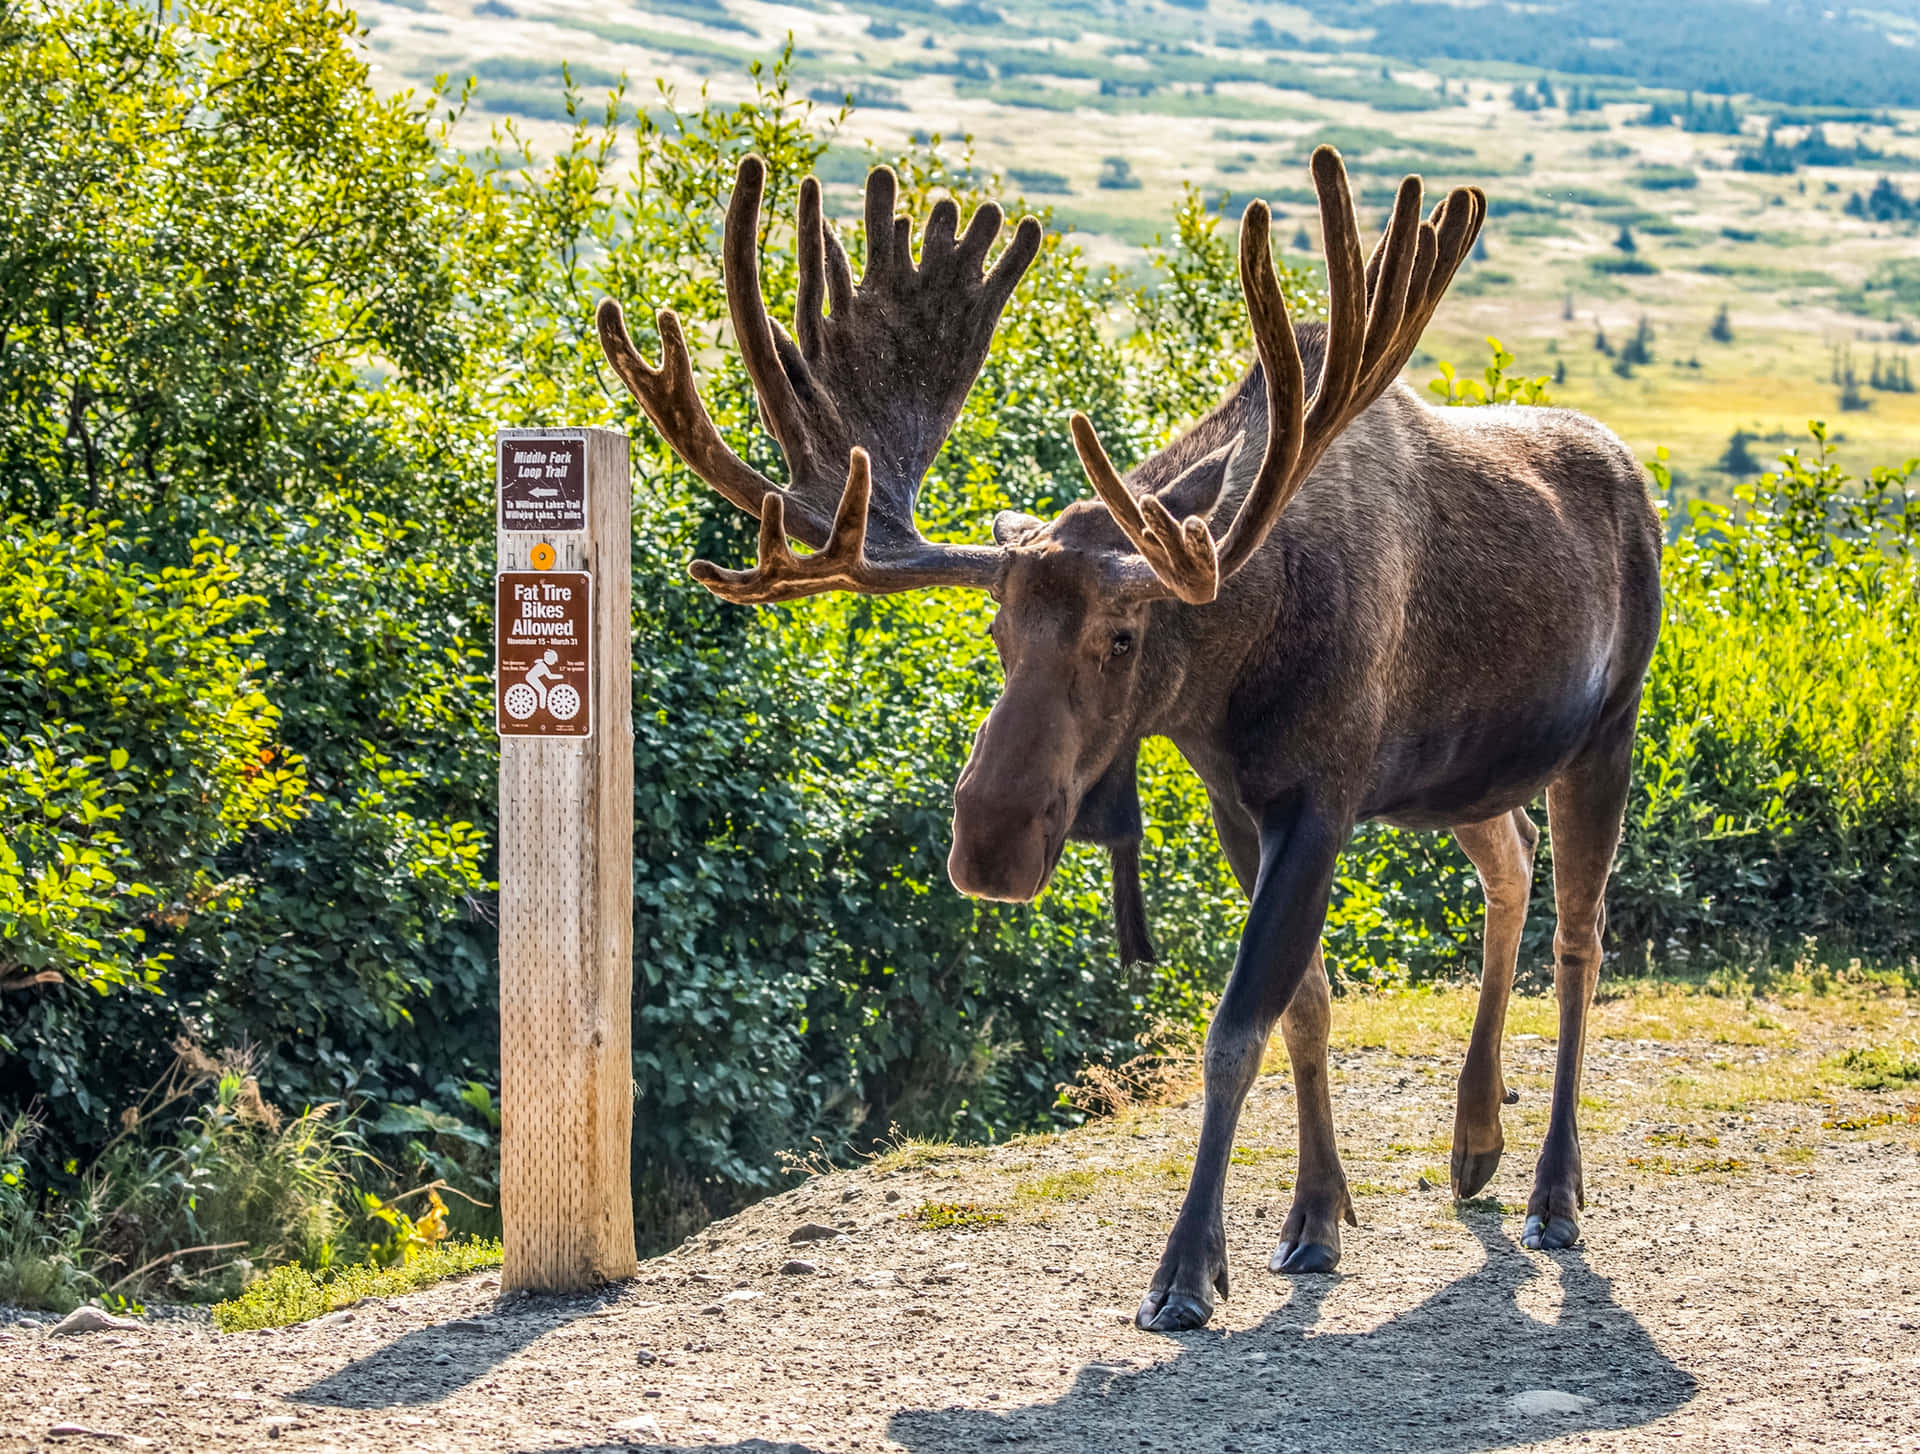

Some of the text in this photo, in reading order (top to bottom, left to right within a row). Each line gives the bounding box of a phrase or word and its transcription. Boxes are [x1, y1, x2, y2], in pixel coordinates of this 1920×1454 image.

[513, 451, 572, 464] Middle Fork
[518, 465, 568, 480] Loop Trail
[505, 500, 514, 509] To
[566, 500, 581, 509] Trail
[557, 511, 562, 519] 5
[564, 511, 581, 519] miles
[514, 583, 572, 601] Fat Tire
[521, 601, 564, 618] Bikes
[511, 618, 574, 636] Allowed
[507, 637, 537, 645] November
[538, 637, 546, 645] 15
[550, 637, 570, 645] March
